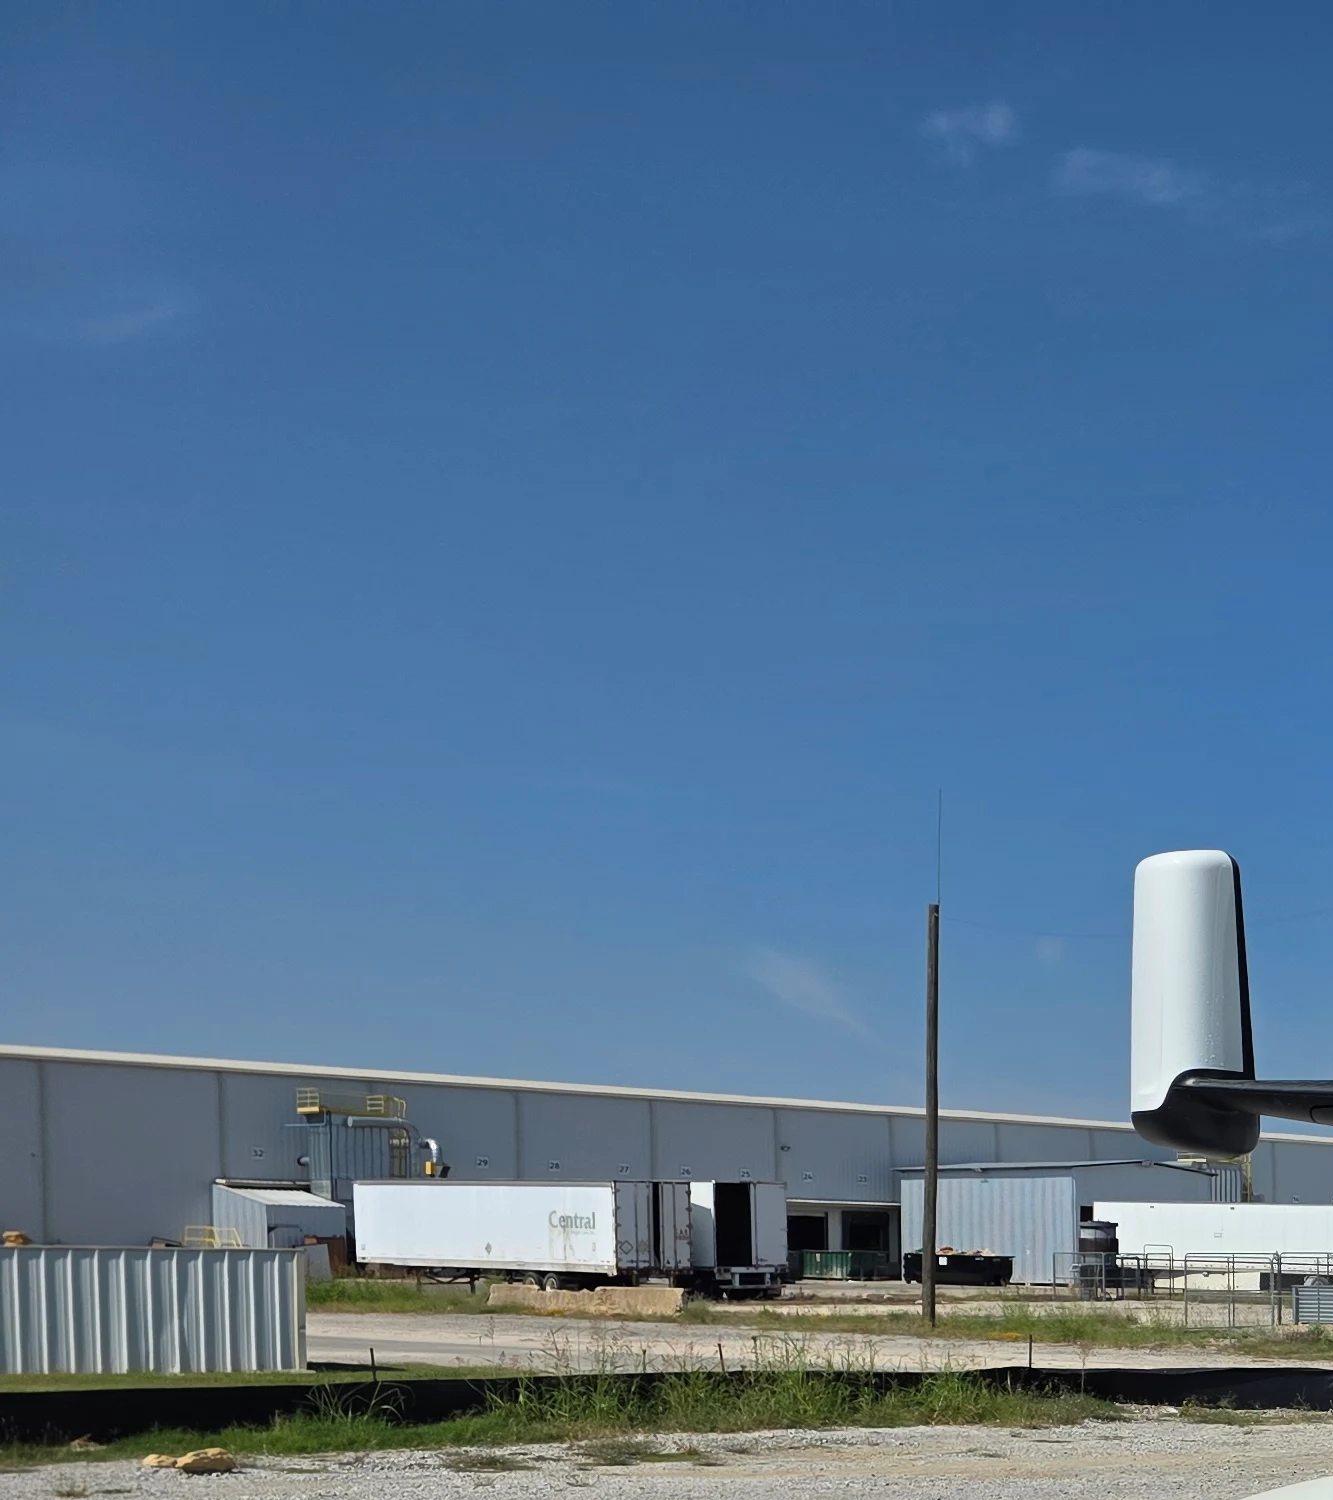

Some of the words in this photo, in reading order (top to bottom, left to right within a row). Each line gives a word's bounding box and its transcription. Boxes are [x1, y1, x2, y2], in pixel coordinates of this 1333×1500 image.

[477, 1158, 488, 1166] 29
[619, 1165, 629, 1173] 27
[548, 1210, 596, 1230] Central
